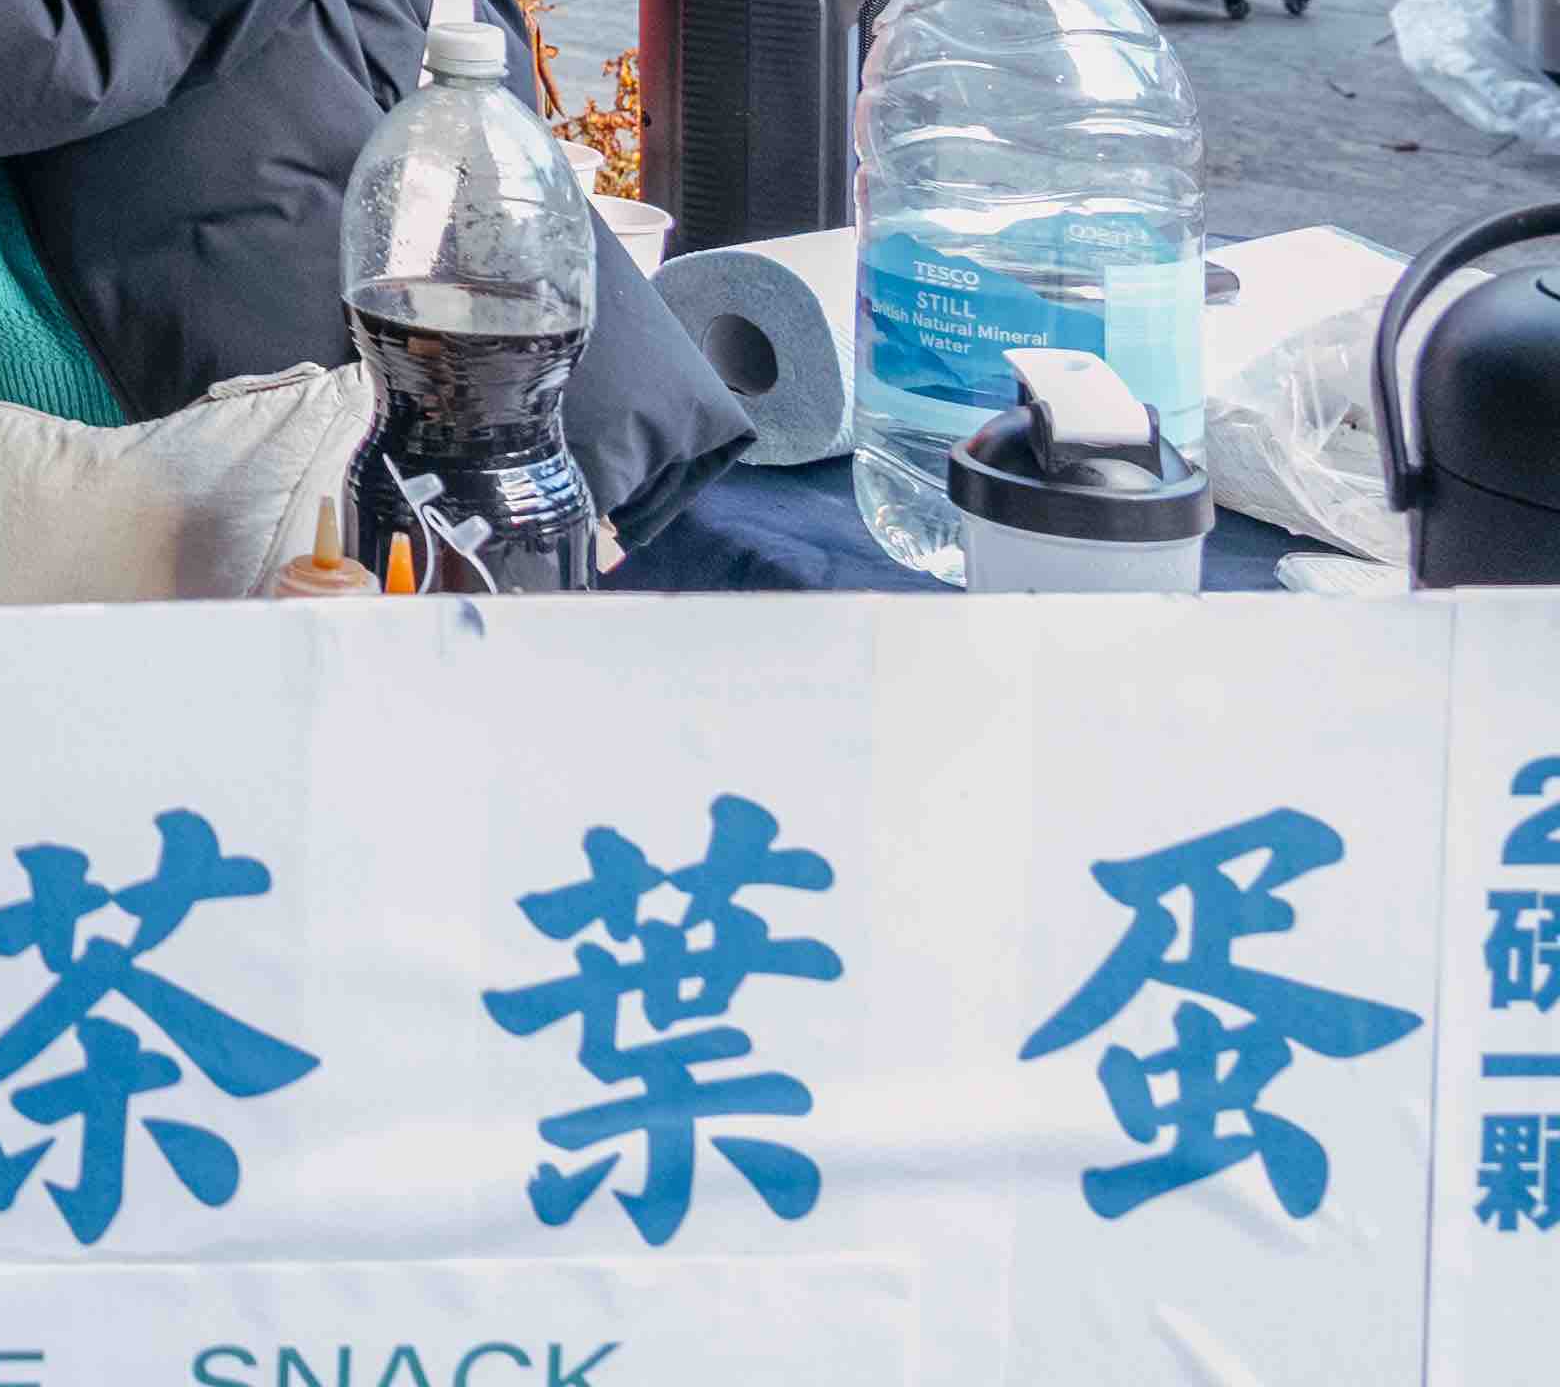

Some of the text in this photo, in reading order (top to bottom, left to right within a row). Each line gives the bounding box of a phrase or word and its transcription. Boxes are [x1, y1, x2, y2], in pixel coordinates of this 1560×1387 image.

[913, 260, 980, 286] TESCO
[916, 290, 976, 319] STILL
[913, 311, 973, 338] Natural
[977, 324, 1049, 348] Mineral
[919, 331, 973, 355] Water
